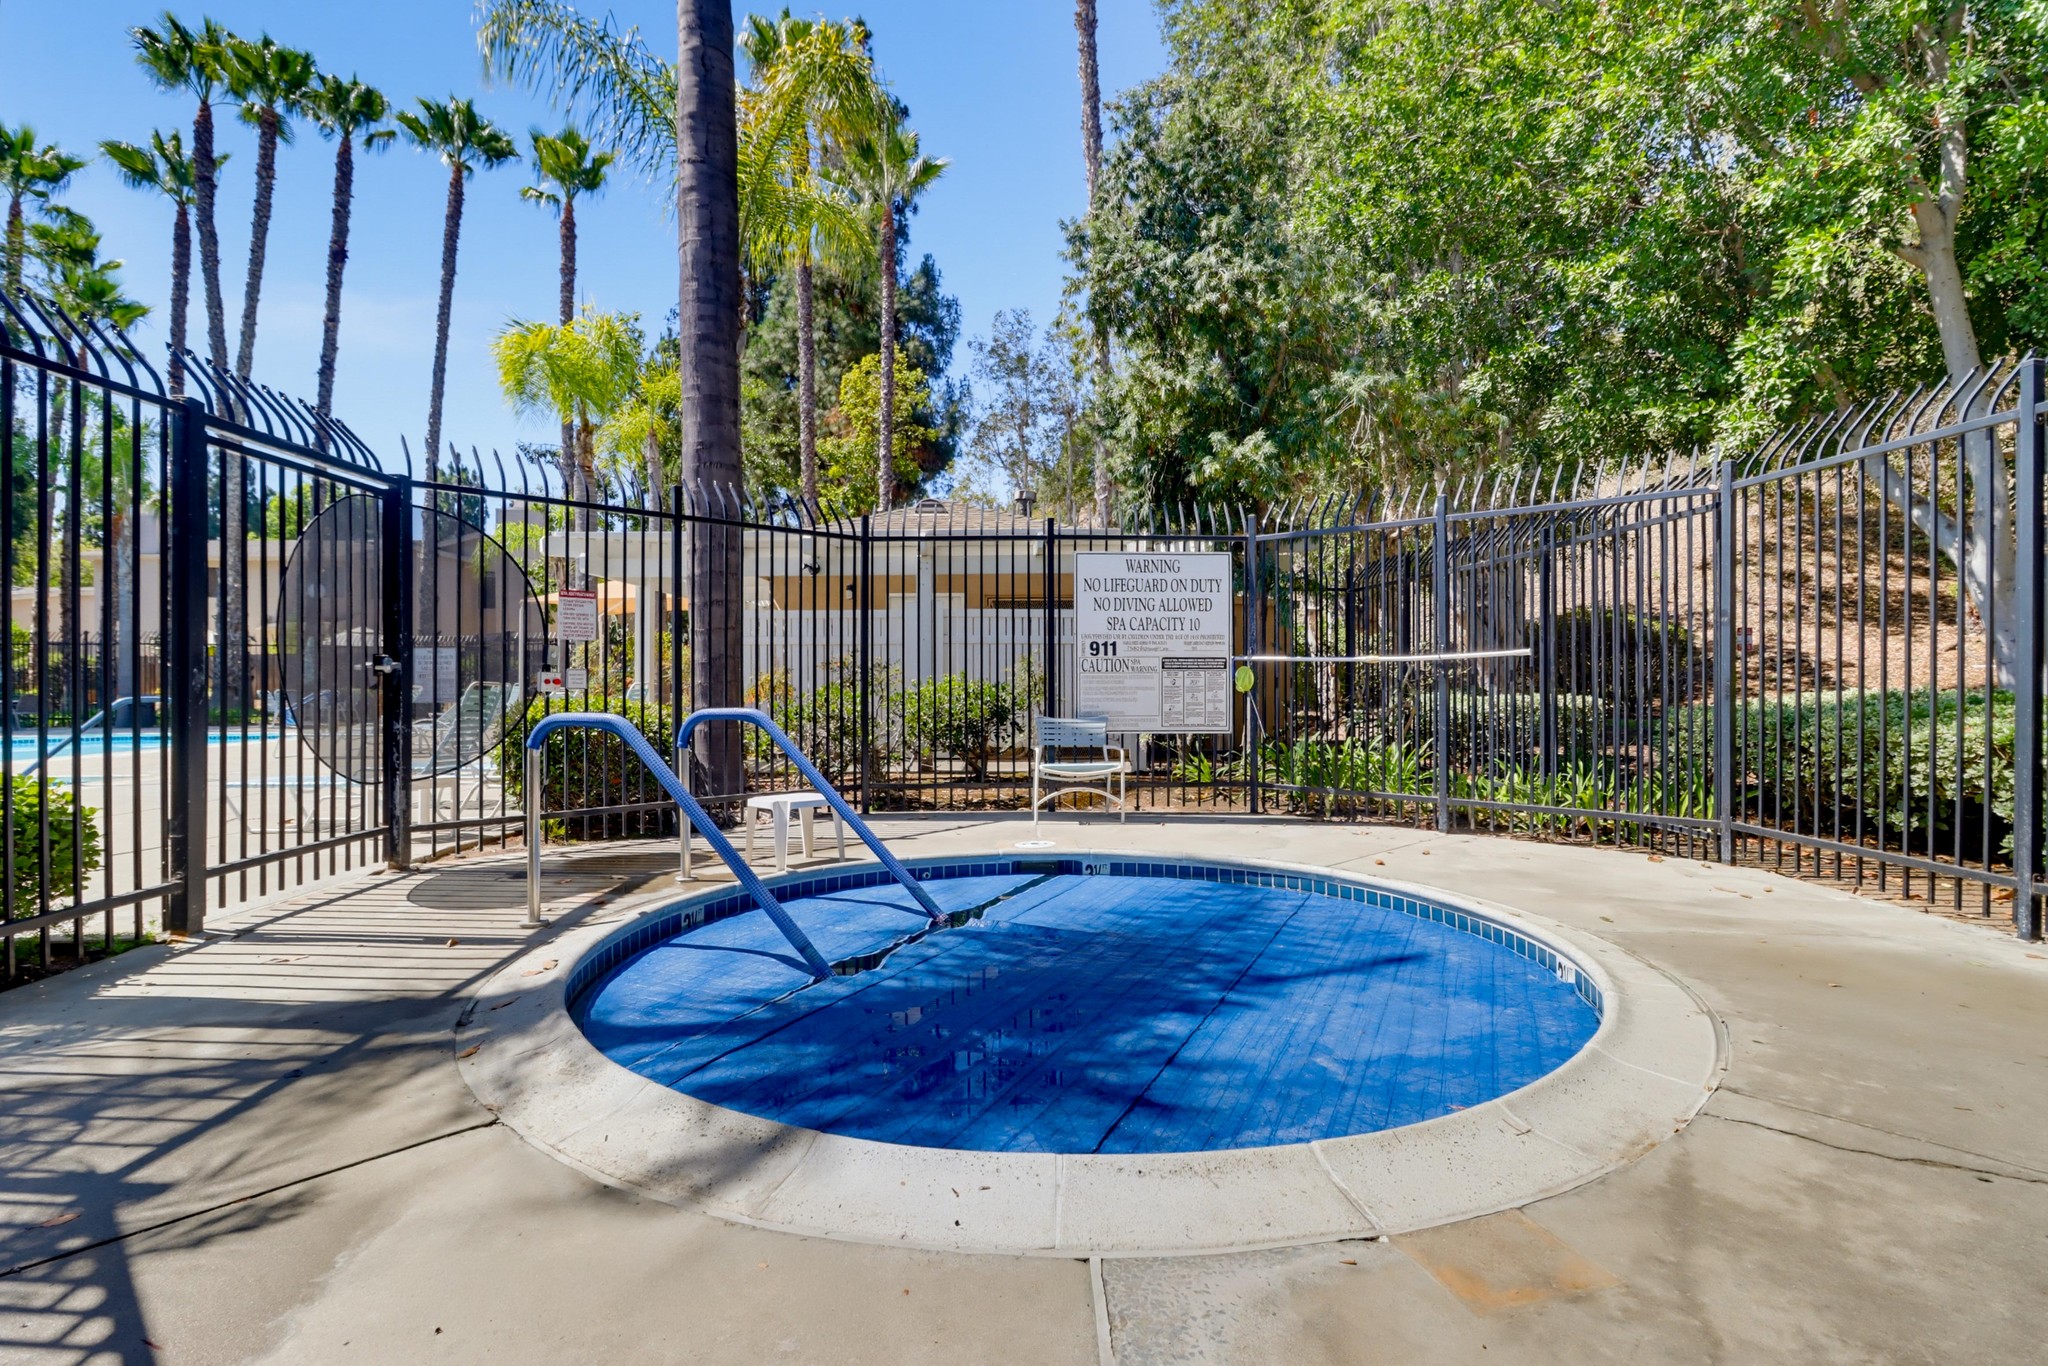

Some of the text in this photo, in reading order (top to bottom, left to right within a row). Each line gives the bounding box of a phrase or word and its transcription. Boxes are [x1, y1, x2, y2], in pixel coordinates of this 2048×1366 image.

[1125, 559, 1181, 574] WARNING
[1083, 578, 1222, 593] NO LIFEGUARD ON DUTY
[1093, 597, 1213, 612] NO DIVING ALLOWED
[1106, 616, 1200, 631] SPA CAPACITY 10
[1089, 640, 1117, 656] 911
[1081, 658, 1130, 673] CAUTION
[1131, 665, 1158, 673] WARNING
